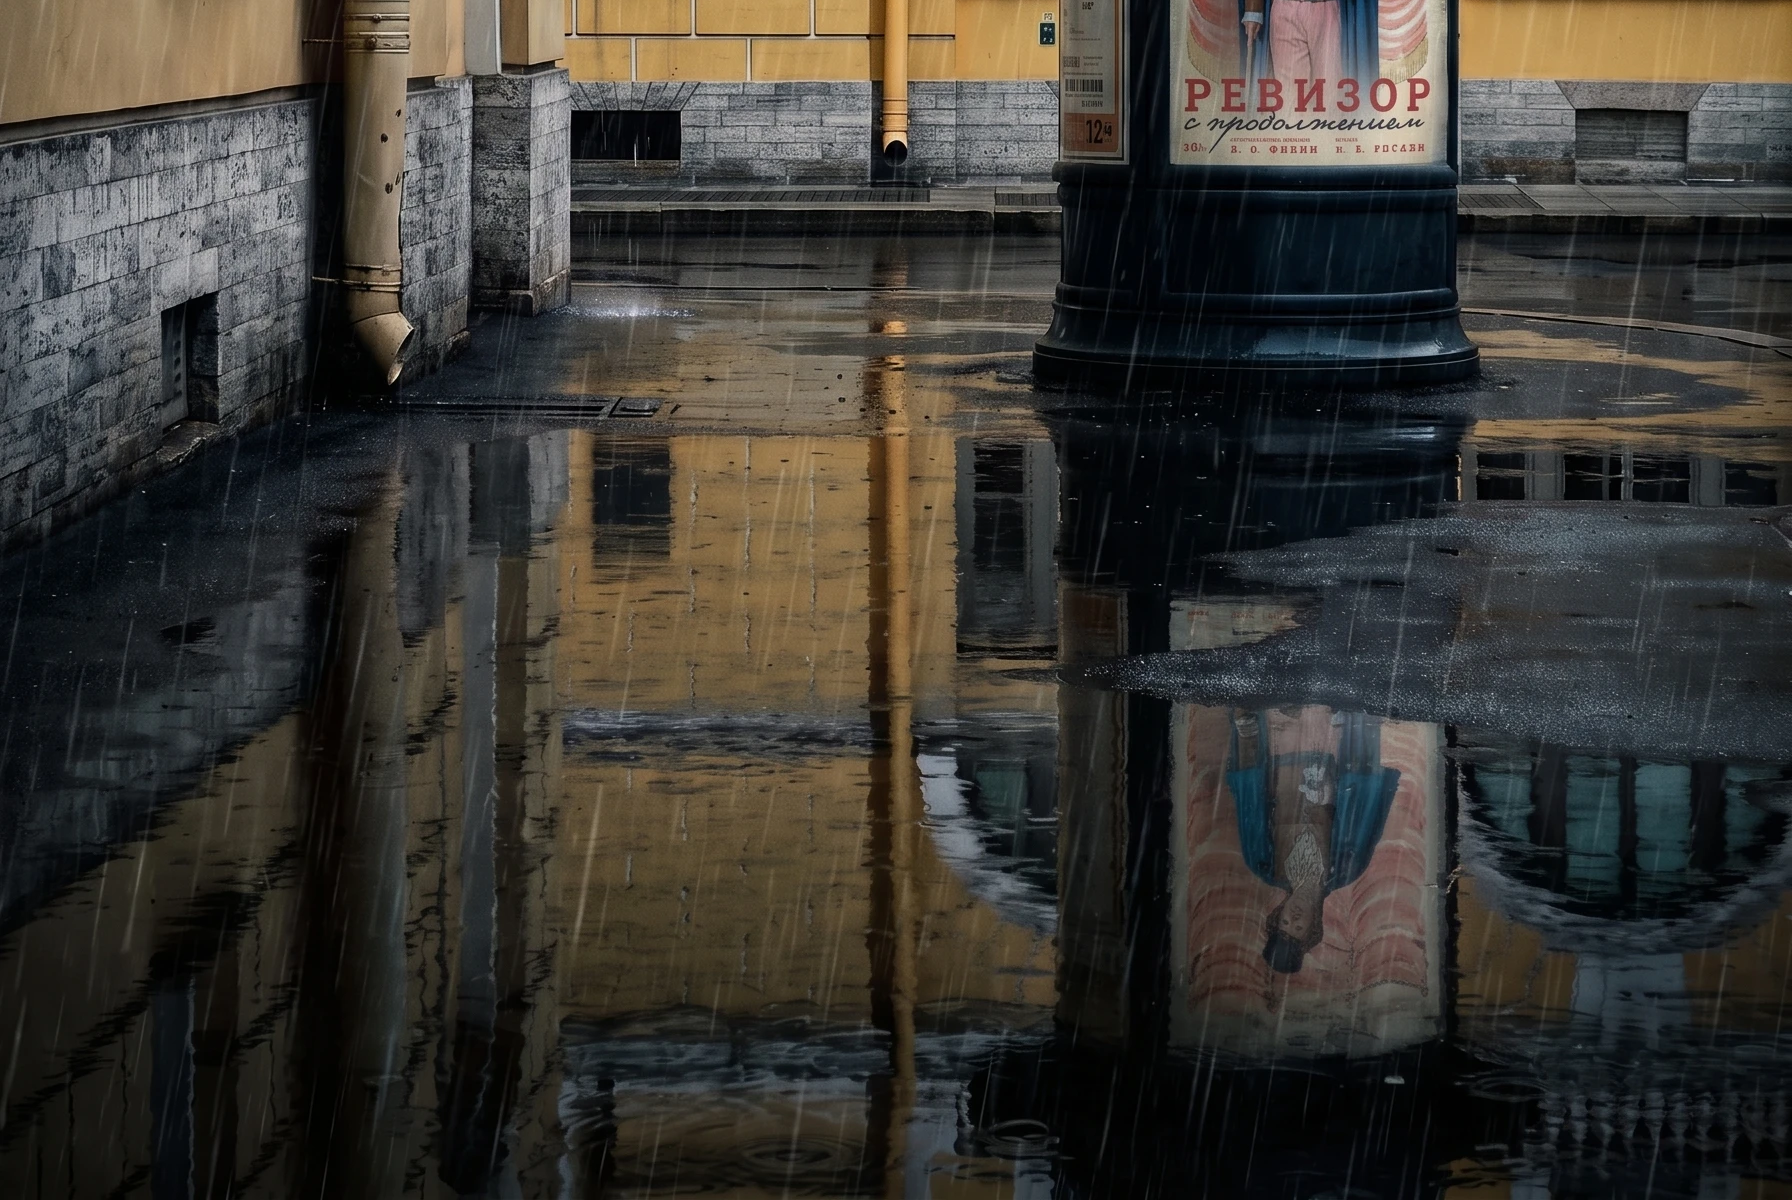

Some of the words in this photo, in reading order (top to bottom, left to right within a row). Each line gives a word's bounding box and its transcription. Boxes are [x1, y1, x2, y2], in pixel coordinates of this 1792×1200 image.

[1184, 78, 1431, 113] РЕВИЗОР
[1184, 117, 1201, 130] с
[1206, 111, 1425, 154] продолжением
